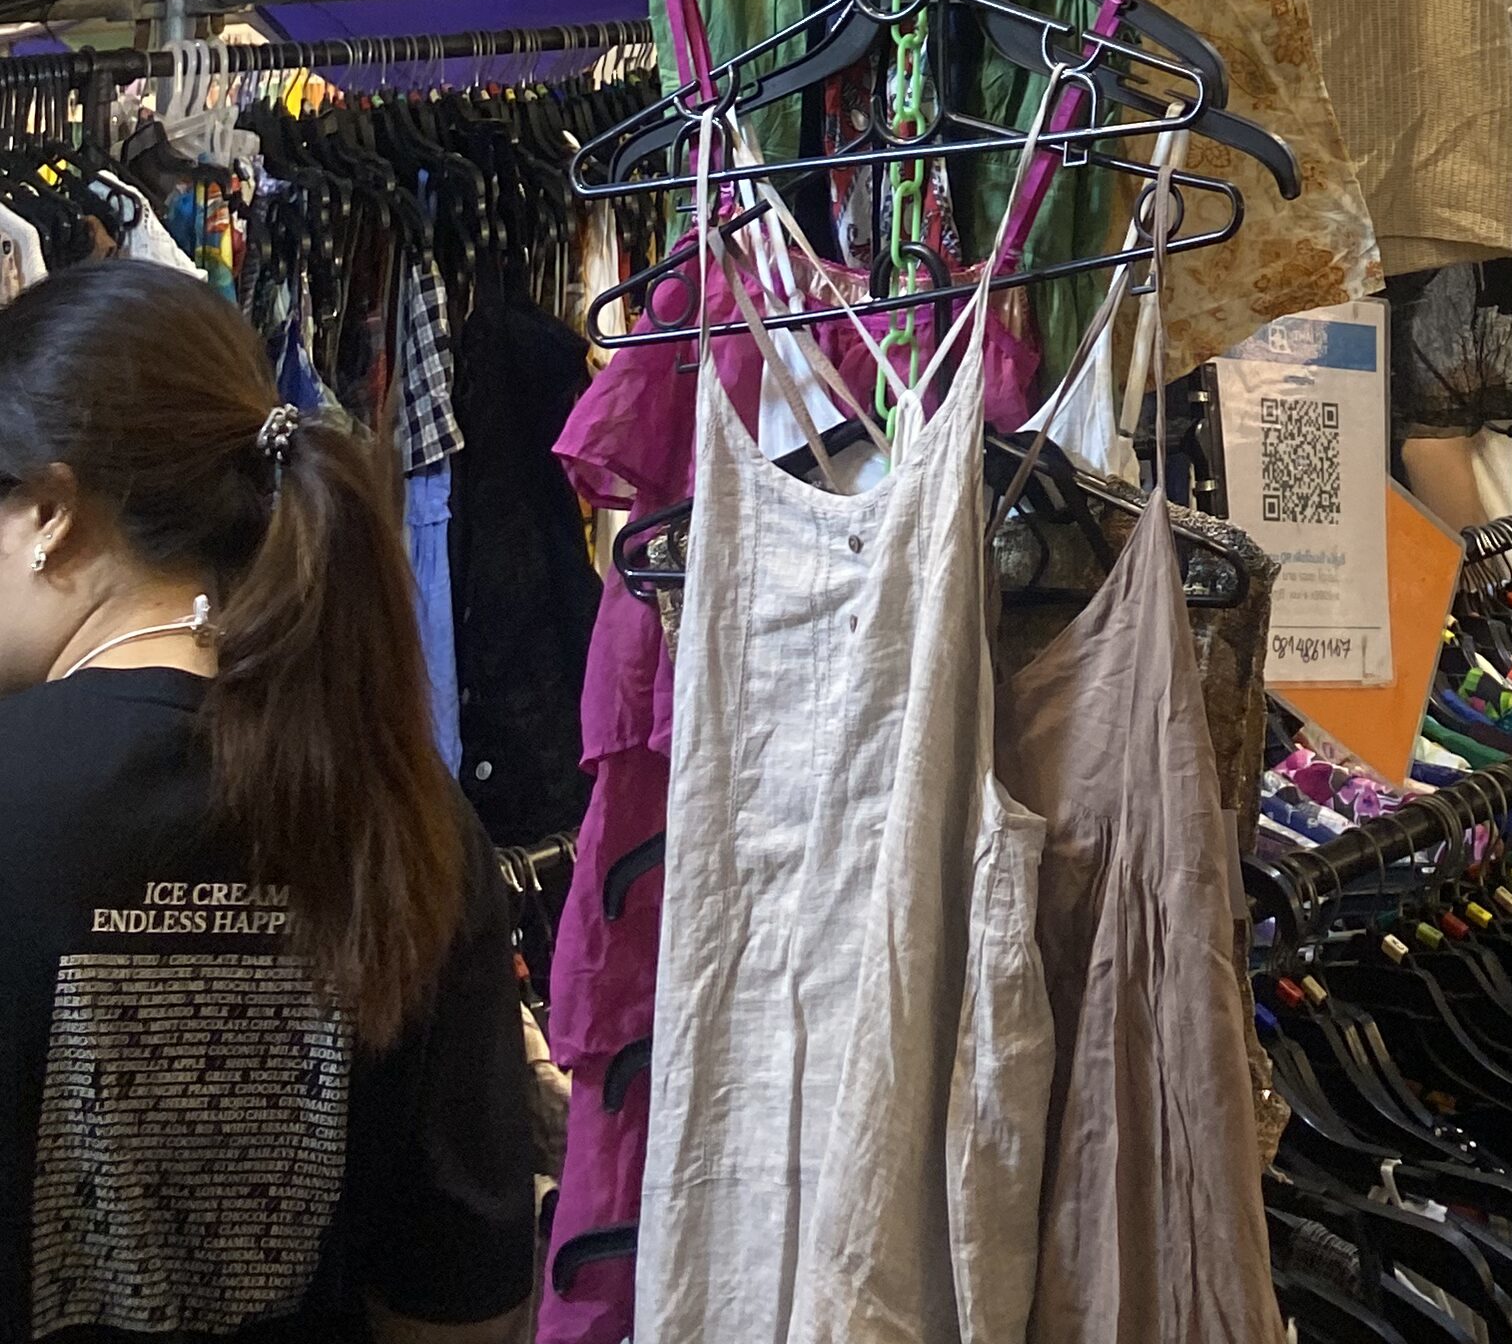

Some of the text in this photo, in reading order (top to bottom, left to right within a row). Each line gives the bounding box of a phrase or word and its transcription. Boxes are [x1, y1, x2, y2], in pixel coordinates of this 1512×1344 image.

[143, 882, 290, 907] ICE CREAM
[91, 909, 207, 933] ENDLESS
[249, 1071, 299, 1082] YOGURT
[234, 1084, 308, 1095] CHOCOLATE
[245, 1109, 290, 1120] CHEESE
[279, 1199, 306, 1211] RED
